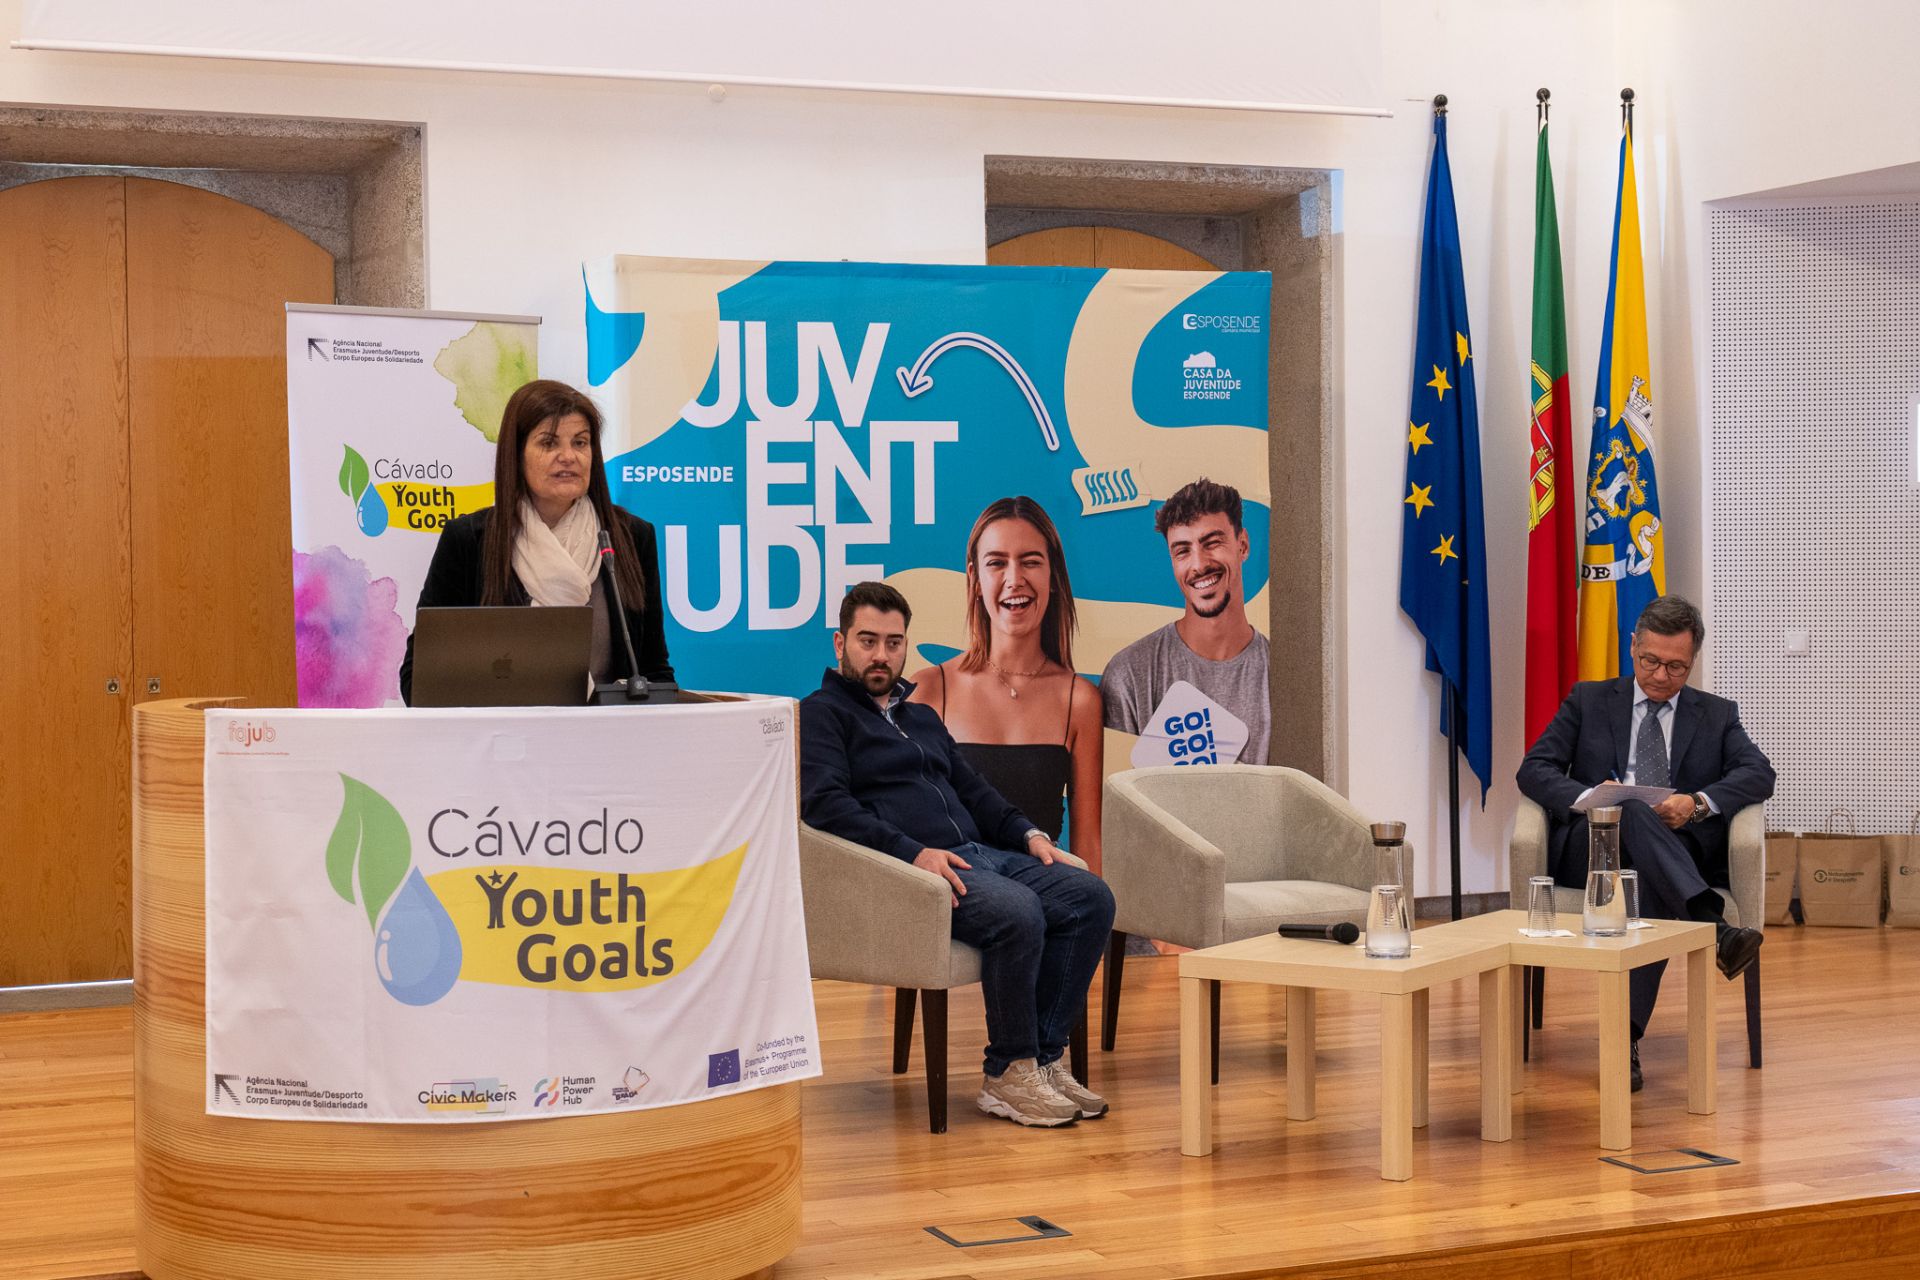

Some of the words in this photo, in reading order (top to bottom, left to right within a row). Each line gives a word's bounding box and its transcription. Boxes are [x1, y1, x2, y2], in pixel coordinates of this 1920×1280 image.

[333, 339, 355, 347] Agência
[333, 354, 351, 362] Corpo
[679, 320, 891, 428] JUV
[1183, 368, 1213, 379] CASA
[1216, 368, 1232, 379] DA
[1183, 380, 1241, 390] JUVENTUDE
[1183, 391, 1231, 400] ESPOSENDE
[374, 458, 453, 479] Cávado
[622, 465, 734, 483] ESPOSENDE
[746, 420, 959, 526] ENT
[1084, 468, 1138, 507] HELLO
[392, 484, 455, 507] Youth
[407, 507, 468, 529] Goal
[1164, 707, 1212, 736] GO!
[1168, 730, 1216, 759] GO!
[428, 806, 643, 858] Cávado
[475, 869, 646, 929] Youth
[516, 925, 674, 983] Goals
[786, 1036, 793, 1047] by
[771, 1048, 806, 1060] Programme
[760, 1063, 789, 1075] European
[790, 1059, 808, 1068] Union
[246, 1076, 275, 1086] Agência
[276, 1078, 308, 1088] Nacional
[562, 1076, 596, 1085] Human
[246, 1086, 282, 1095] Erasmus+
[284, 1088, 364, 1100] Juventude/Desporto
[418, 1091, 457, 1104] Civic
[461, 1089, 518, 1104] Makers
[562, 1086, 594, 1095] Power
[246, 1095, 269, 1105] Corpo
[270, 1097, 301, 1106] Europeu
[302, 1099, 312, 1107] de
[313, 1100, 368, 1109] Solidariedade
[562, 1096, 583, 1105] Hub
